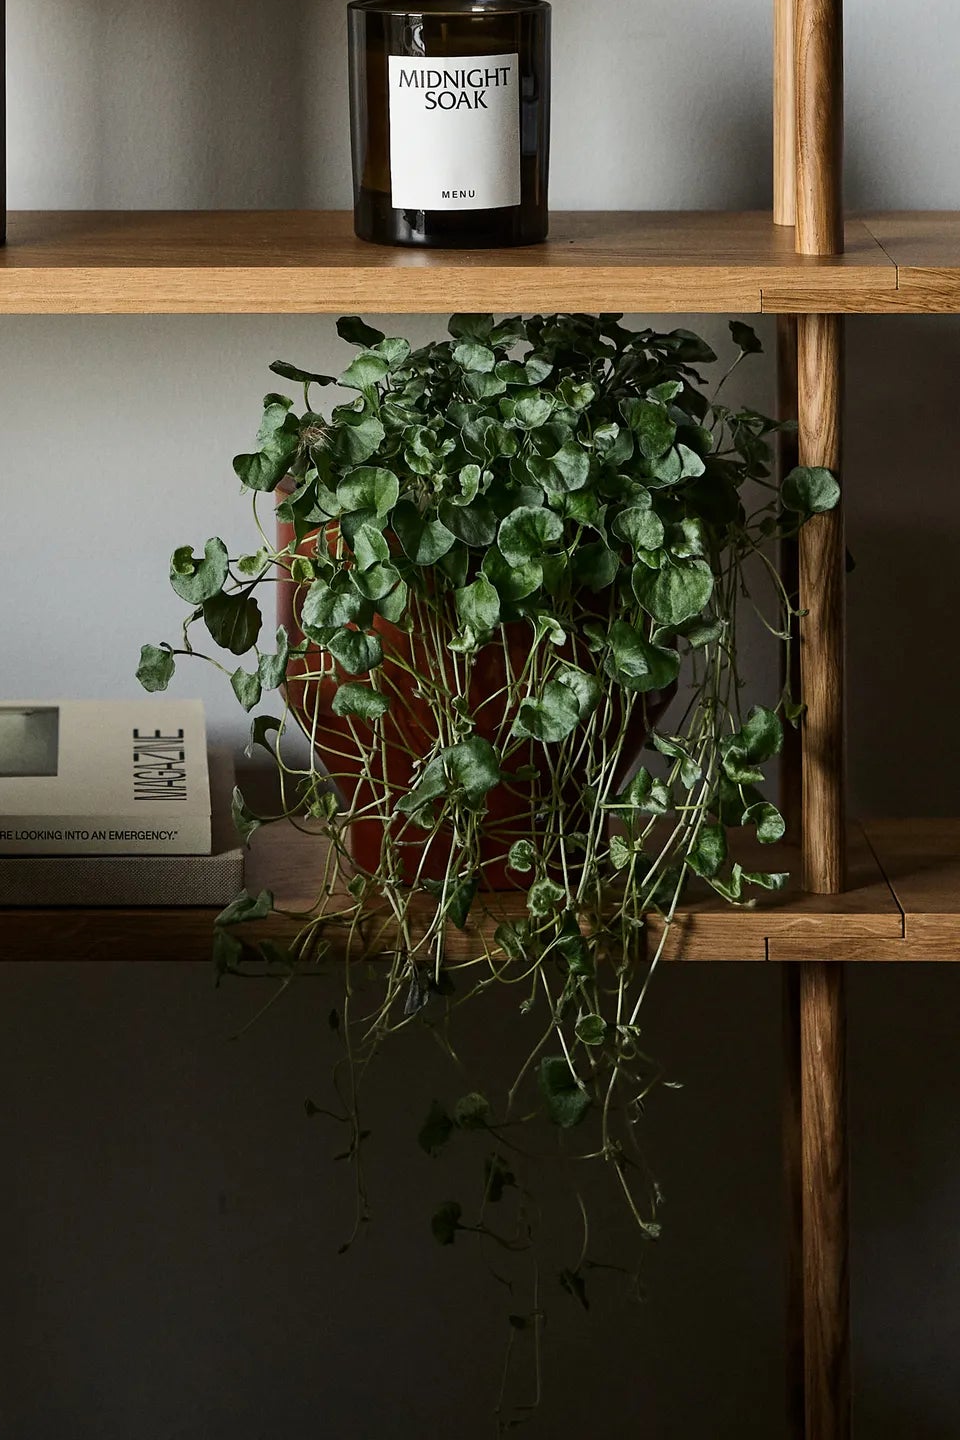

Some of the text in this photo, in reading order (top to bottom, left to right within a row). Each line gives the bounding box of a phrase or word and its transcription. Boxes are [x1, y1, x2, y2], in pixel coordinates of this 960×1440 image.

[398, 67, 511, 89] MIDNIGHT
[425, 90, 488, 110] SOAK
[442, 190, 476, 199] MENU
[133, 728, 187, 800] MAGAZINE
[15, 830, 62, 840] LOOKING
[65, 830, 89, 840] INTO
[91, 830, 107, 840] AN
